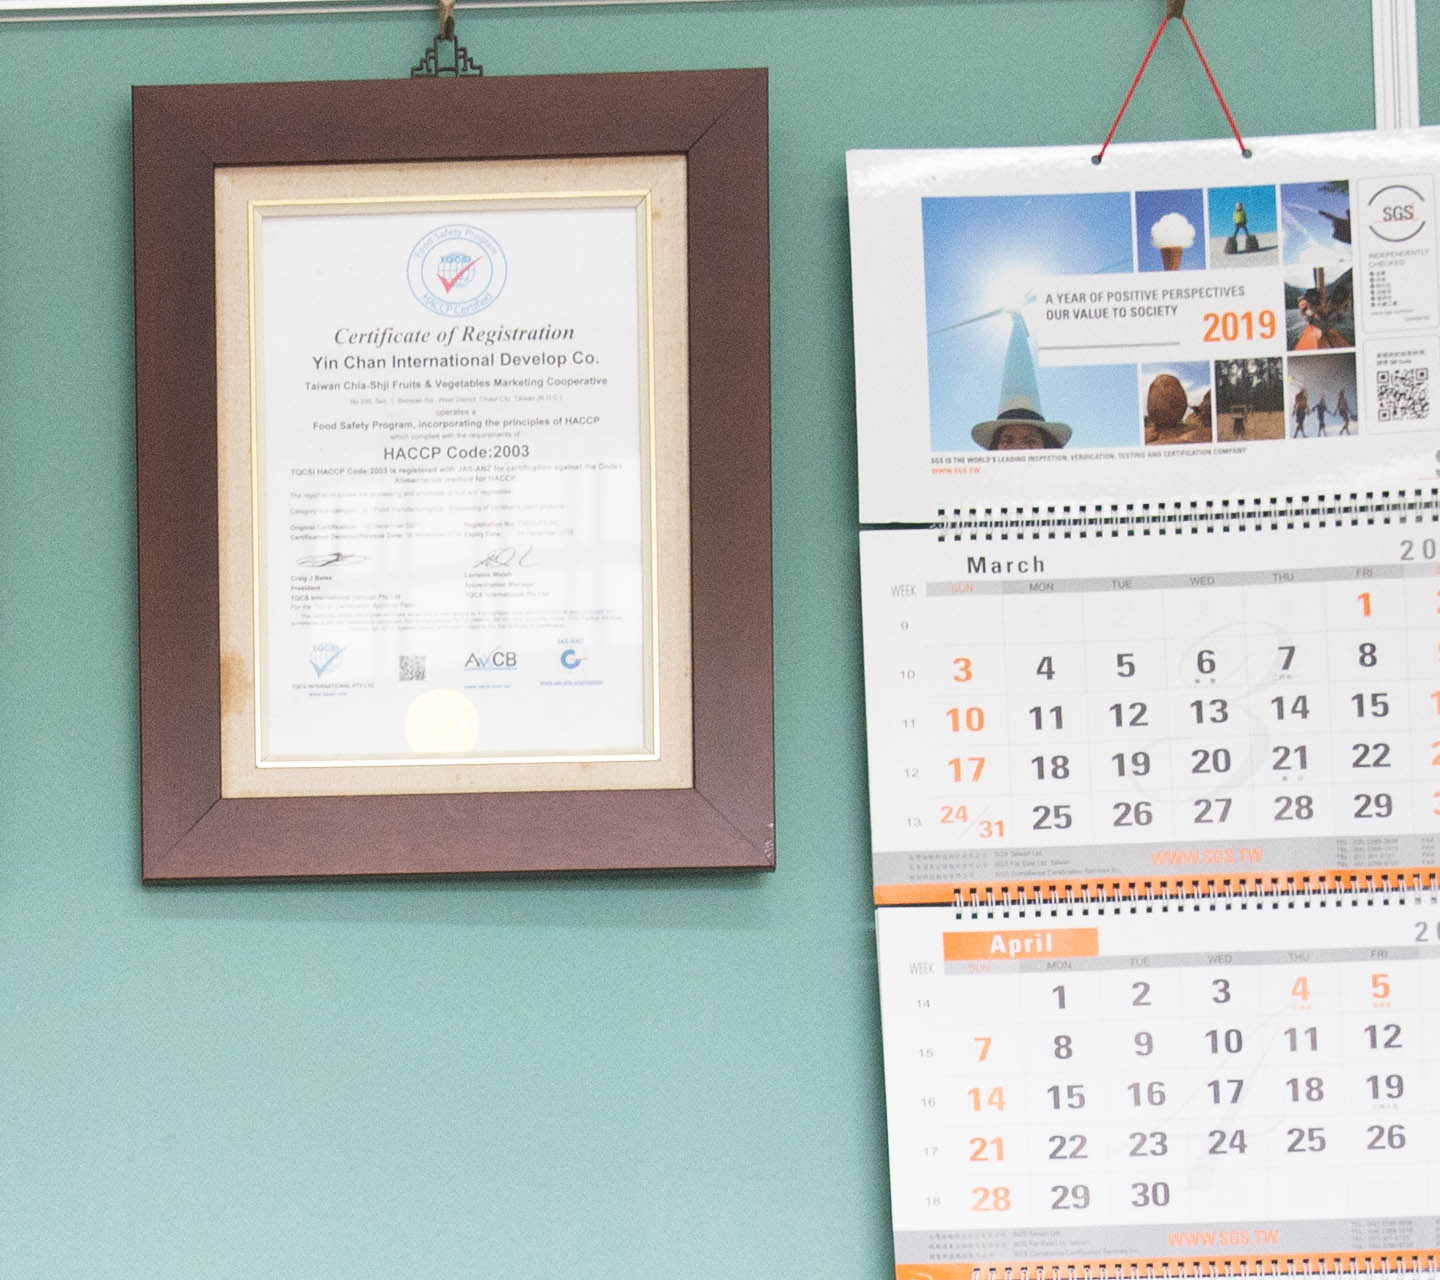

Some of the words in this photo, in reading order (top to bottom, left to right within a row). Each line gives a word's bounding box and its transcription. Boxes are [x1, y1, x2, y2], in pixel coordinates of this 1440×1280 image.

[1383, 204, 1413, 224] SGS
[1046, 294, 1052, 303] A
[1057, 293, 1085, 303] YEAR
[1090, 293, 1101, 302] OF
[1107, 290, 1155, 303] POSITIVE
[1162, 286, 1244, 299] PERSPECTIVES
[1047, 310, 1069, 320] OUR
[1073, 308, 1106, 318] VALUE
[1114, 308, 1126, 317] TO
[1131, 306, 1177, 317] SOCIETY
[335, 328, 430, 347] Certificate
[437, 328, 455, 346] of
[462, 325, 574, 344] Registration
[1204, 311, 1275, 341] 2019
[312, 356, 338, 370] Yin
[344, 356, 385, 369] Chan
[393, 353, 494, 368] International
[501, 352, 566, 368] Develop
[573, 351, 598, 364] Co.
[305, 381, 341, 391] Taiwan
[392, 380, 421, 389] Fruits
[425, 379, 432, 388] &
[435, 378, 491, 390] Vegetables
[493, 378, 544, 388] Marketing
[546, 376, 608, 388] Cooperative
[312, 421, 337, 431] Food
[339, 421, 370, 431] Safety
[372, 420, 416, 431] Program,
[418, 419, 483, 429] incorporating
[484, 419, 500, 427] the
[502, 417, 550, 428] principles
[552, 416, 563, 425] of
[564, 415, 600, 425] HACCP
[383, 446, 442, 460] HACCP
[447, 445, 529, 458] Code:2003
[953, 456, 966, 464] THE
[1148, 450, 1161, 458] AND
[1214, 447, 1246, 456] COMPANY
[968, 556, 1043, 573] March
[954, 658, 972, 682] 3
[1037, 656, 1055, 680] 4
[1117, 653, 1135, 677] 5
[1197, 650, 1215, 674] 6
[1278, 646, 1295, 670] 7
[1359, 643, 1377, 667] 8
[947, 707, 984, 732] 10
[1030, 706, 1062, 730] 11
[1110, 703, 1148, 727] 12
[1191, 699, 1228, 723] 13
[1272, 696, 1309, 720] 14
[1352, 693, 1389, 717] 15
[1152, 848, 1264, 869] WWW.SGS.TW
[989, 933, 1054, 957] April
[968, 1087, 1006, 1112] 14
[1048, 1085, 1085, 1109] 15
[1128, 1082, 1165, 1106] 16
[1208, 1080, 1243, 1104] 17
[1286, 1077, 1324, 1102] 18
[1367, 1075, 1403, 1099] 19
[1164, 1226, 1283, 1250] WWW.SGS.TW
